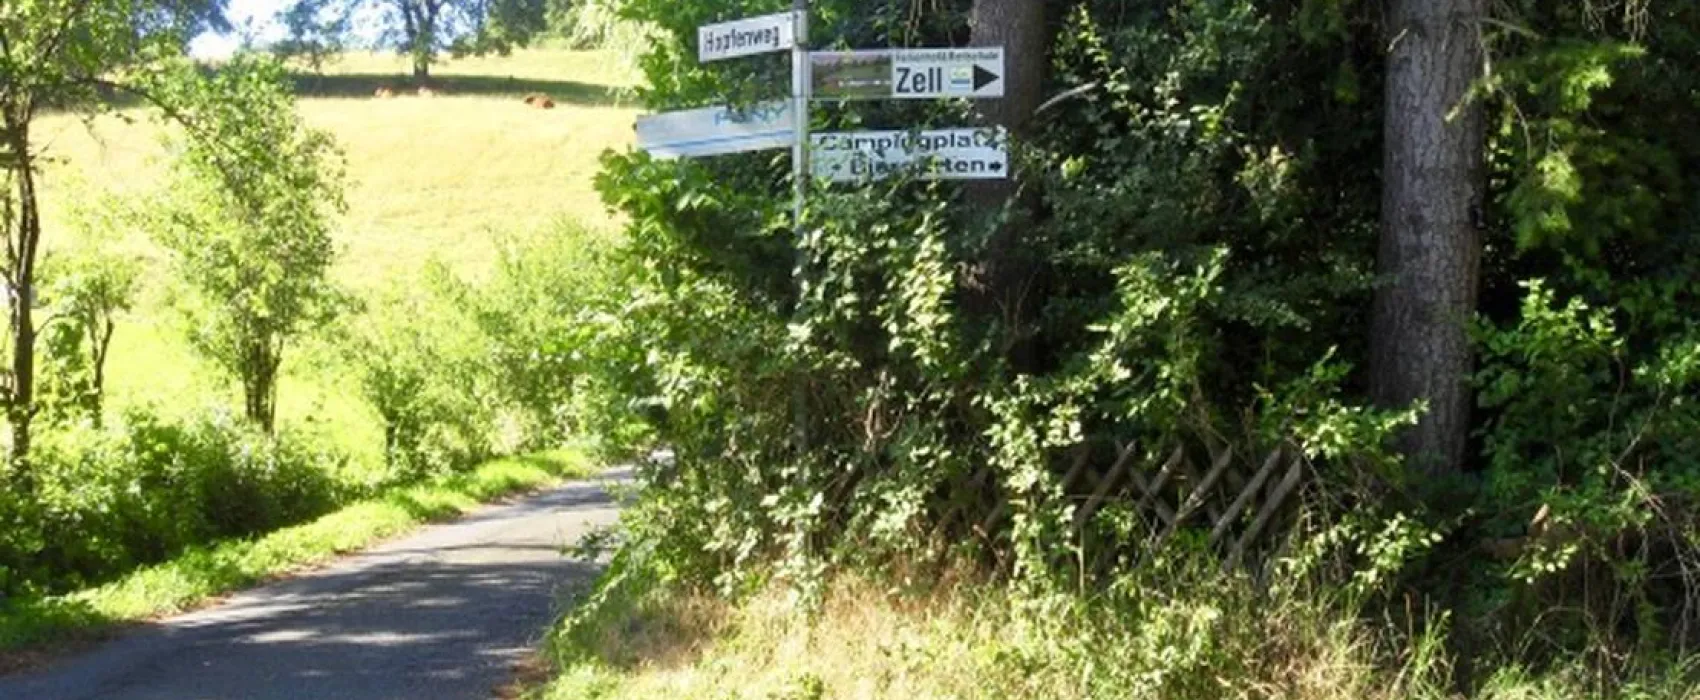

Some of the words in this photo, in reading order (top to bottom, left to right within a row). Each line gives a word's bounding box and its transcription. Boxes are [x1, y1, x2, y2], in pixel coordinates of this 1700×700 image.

[704, 26, 779, 53] Hopfenweg
[896, 66, 942, 93] Zell
[819, 128, 1000, 152] Campigpla
